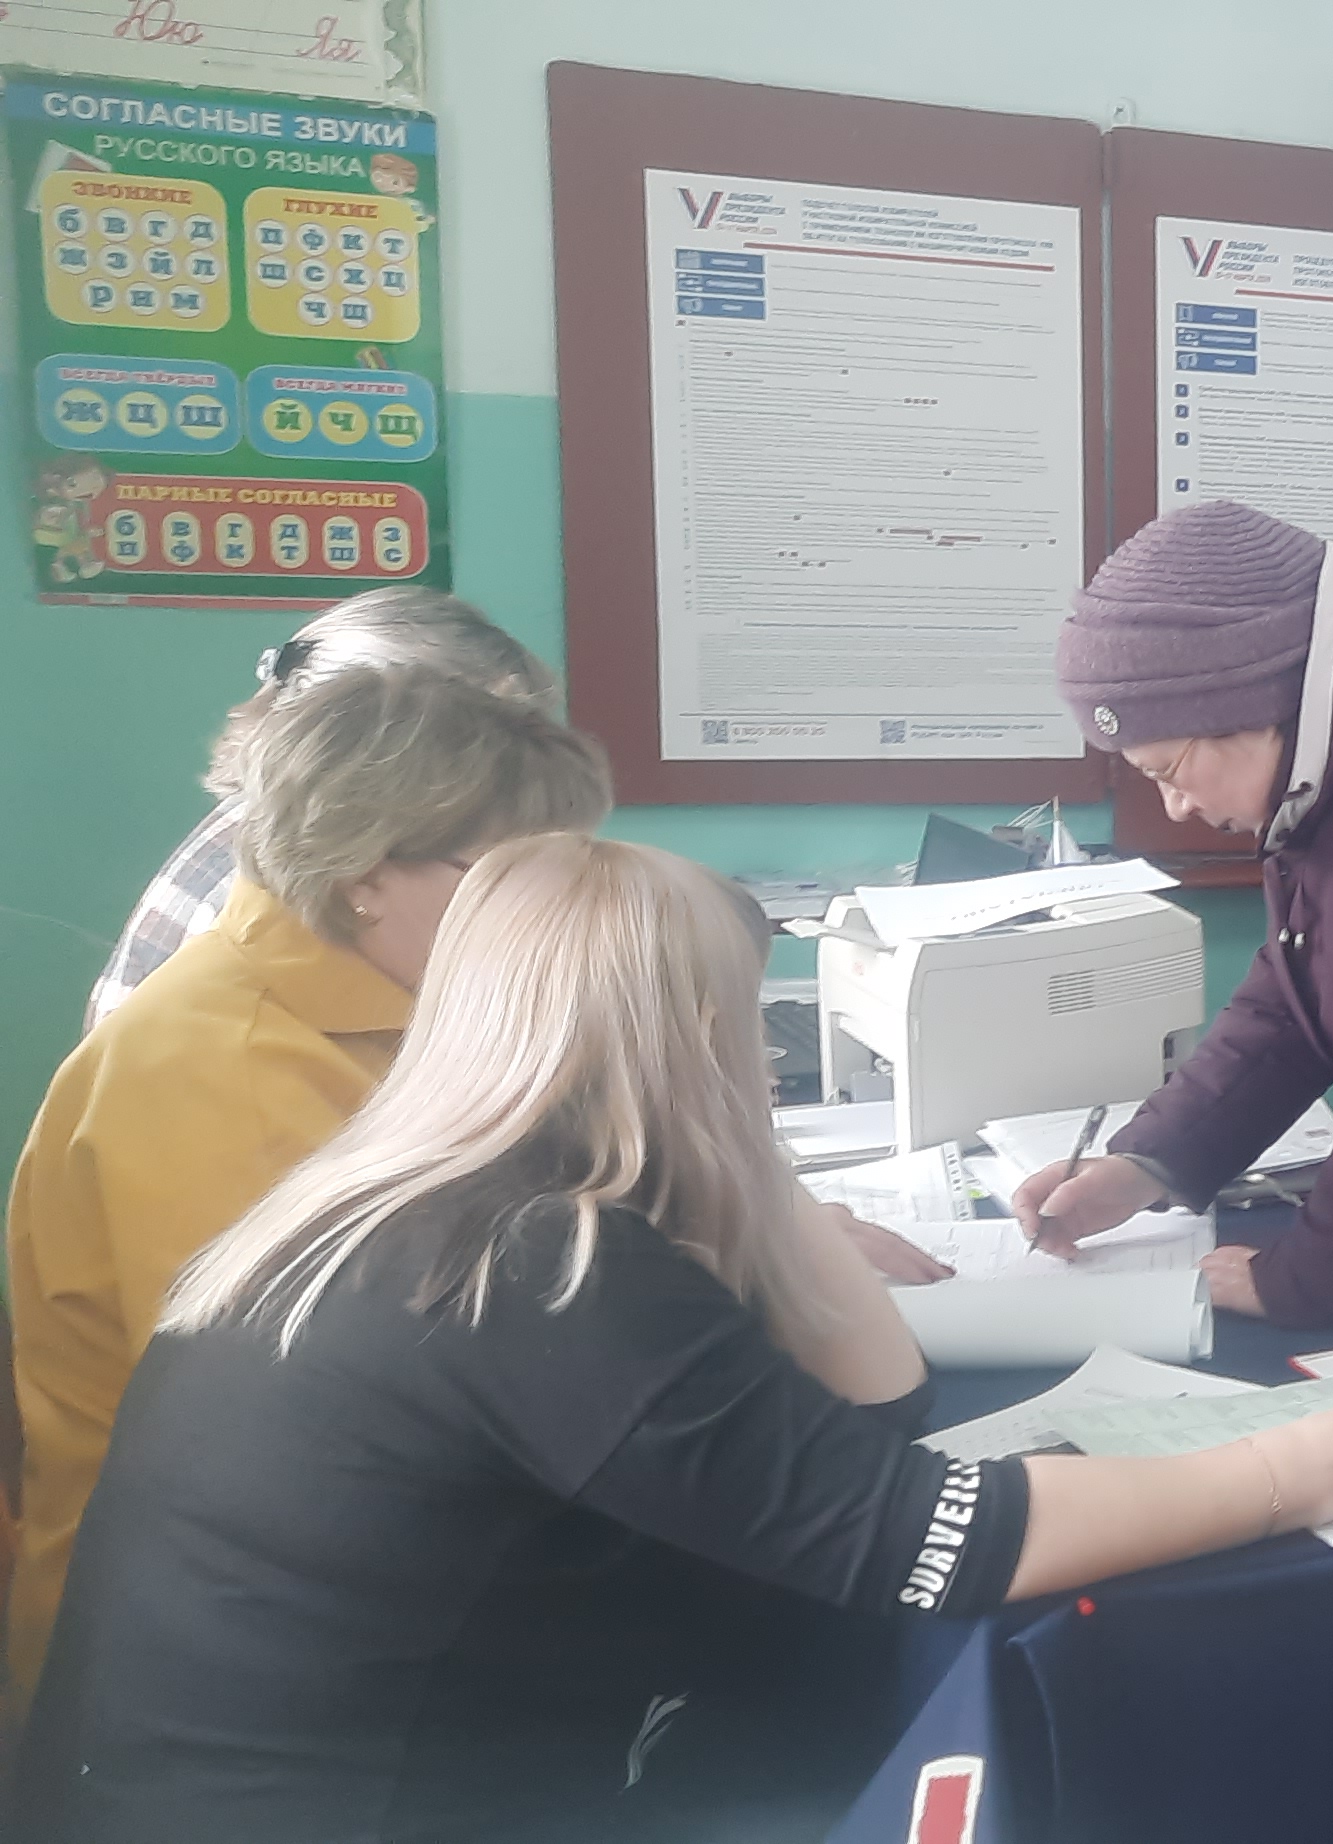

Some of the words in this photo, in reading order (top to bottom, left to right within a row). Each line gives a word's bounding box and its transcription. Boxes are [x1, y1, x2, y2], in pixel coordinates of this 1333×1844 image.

[43, 91, 282, 137] СОГЛАСНЫЕ
[293, 115, 408, 148] ЗВУКИ
[94, 134, 256, 169] РУССКОГО
[265, 150, 366, 178] ЯЗЫКА
[59, 208, 80, 233] б
[104, 217, 126, 233] в
[148, 220, 168, 238] г
[191, 221, 214, 241] д
[302, 228, 325, 251] ф
[342, 234, 364, 251] к
[382, 237, 405, 254] т
[106, 251, 128, 270] з
[149, 251, 174, 275] й
[305, 265, 326, 282] с
[343, 268, 367, 286] х
[381, 271, 406, 292] ц
[89, 284, 114, 308] р
[129, 290, 154, 307] н
[171, 292, 201, 310] м
[304, 301, 328, 319] ч
[115, 484, 233, 503] ПАРНЫЕ
[236, 488, 398, 509] СОГЛАСНЫЕ
[115, 513, 137, 537] б
[171, 520, 192, 537] в
[227, 522, 243, 539] г
[278, 522, 300, 542] д
[327, 524, 355, 541] ж
[383, 526, 401, 543] з
[170, 540, 195, 563] ф
[224, 543, 245, 560] к
[280, 544, 300, 560] т
[384, 547, 403, 564] с
